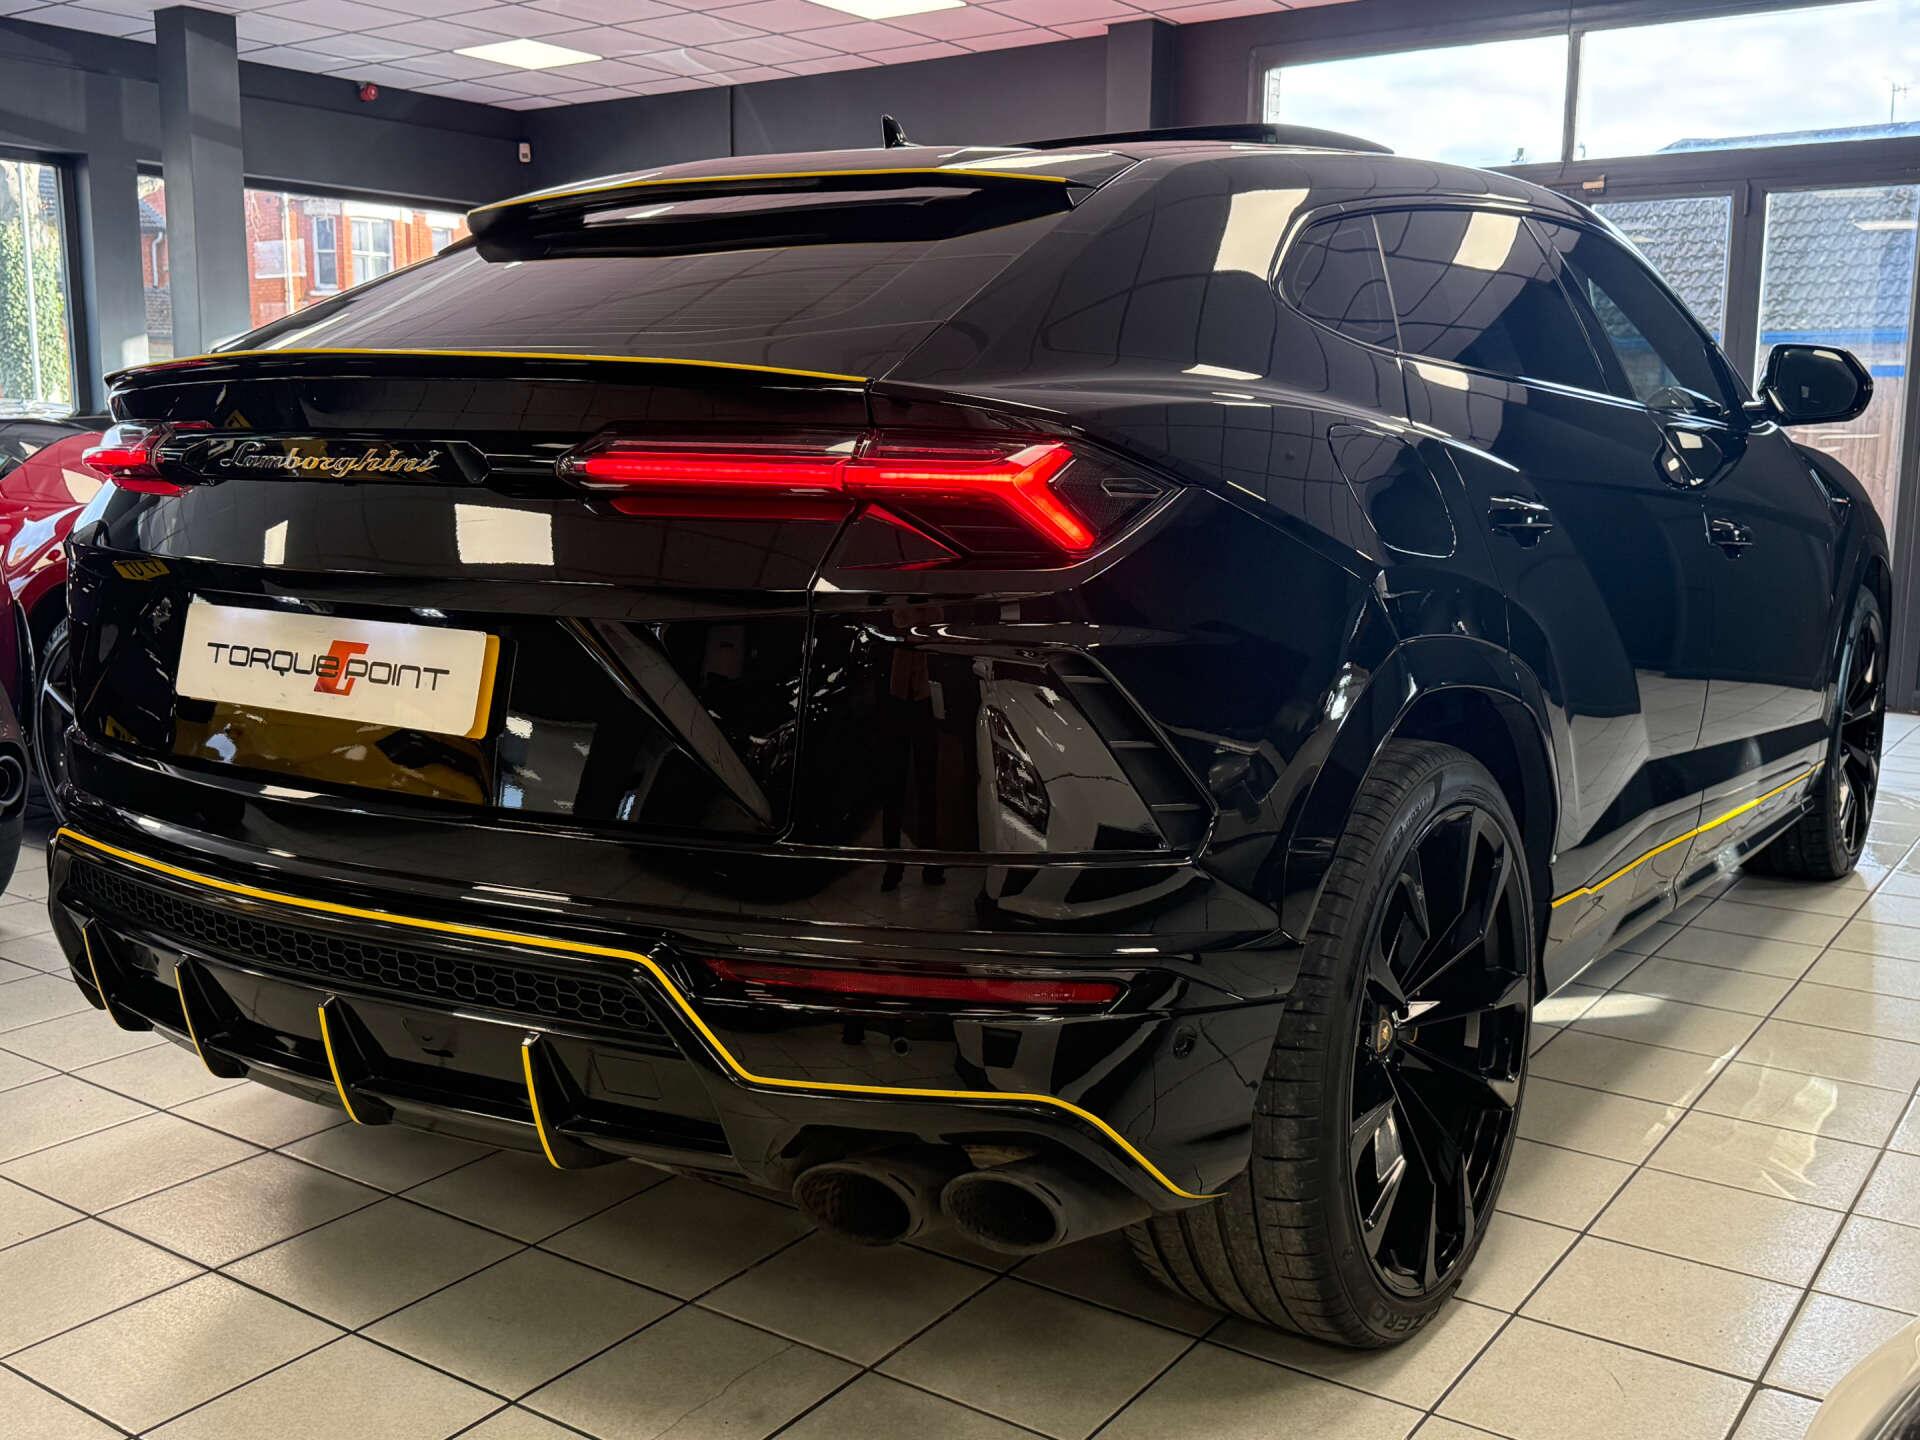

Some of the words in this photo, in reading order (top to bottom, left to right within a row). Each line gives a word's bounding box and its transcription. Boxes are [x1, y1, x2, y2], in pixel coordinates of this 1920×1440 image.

[220, 441, 440, 478] Lamborghini
[207, 641, 340, 678] TORQUE
[345, 658, 450, 691] POINT
